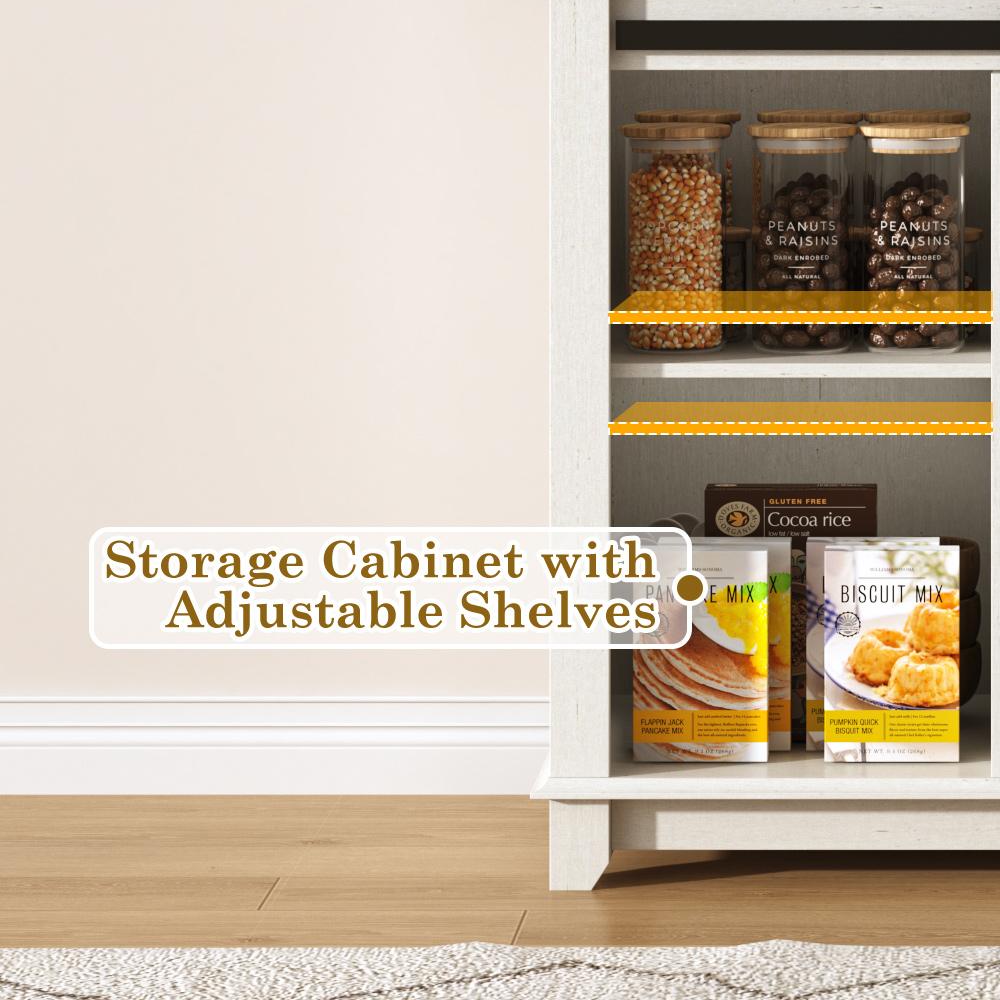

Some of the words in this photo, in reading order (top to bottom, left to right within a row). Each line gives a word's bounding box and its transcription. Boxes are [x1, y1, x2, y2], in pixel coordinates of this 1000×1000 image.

[768, 220, 837, 232] PEANUTS
[880, 220, 948, 232] PEANUTS
[765, 236, 773, 246] &
[779, 235, 839, 246] RAISINS
[877, 236, 885, 246] &
[891, 235, 951, 246] RAISINS
[767, 511, 818, 527] Cocoa
[823, 511, 852, 527] rice
[726, 584, 754, 603] MIX
[841, 584, 906, 603] BISCUIT
[915, 584, 943, 603] MIX
[829, 718, 858, 726] PUMPKIN
[859, 718, 879, 726] QUICK
[835, 727, 859, 735] BISCUIT
[861, 727, 873, 735] MIX
